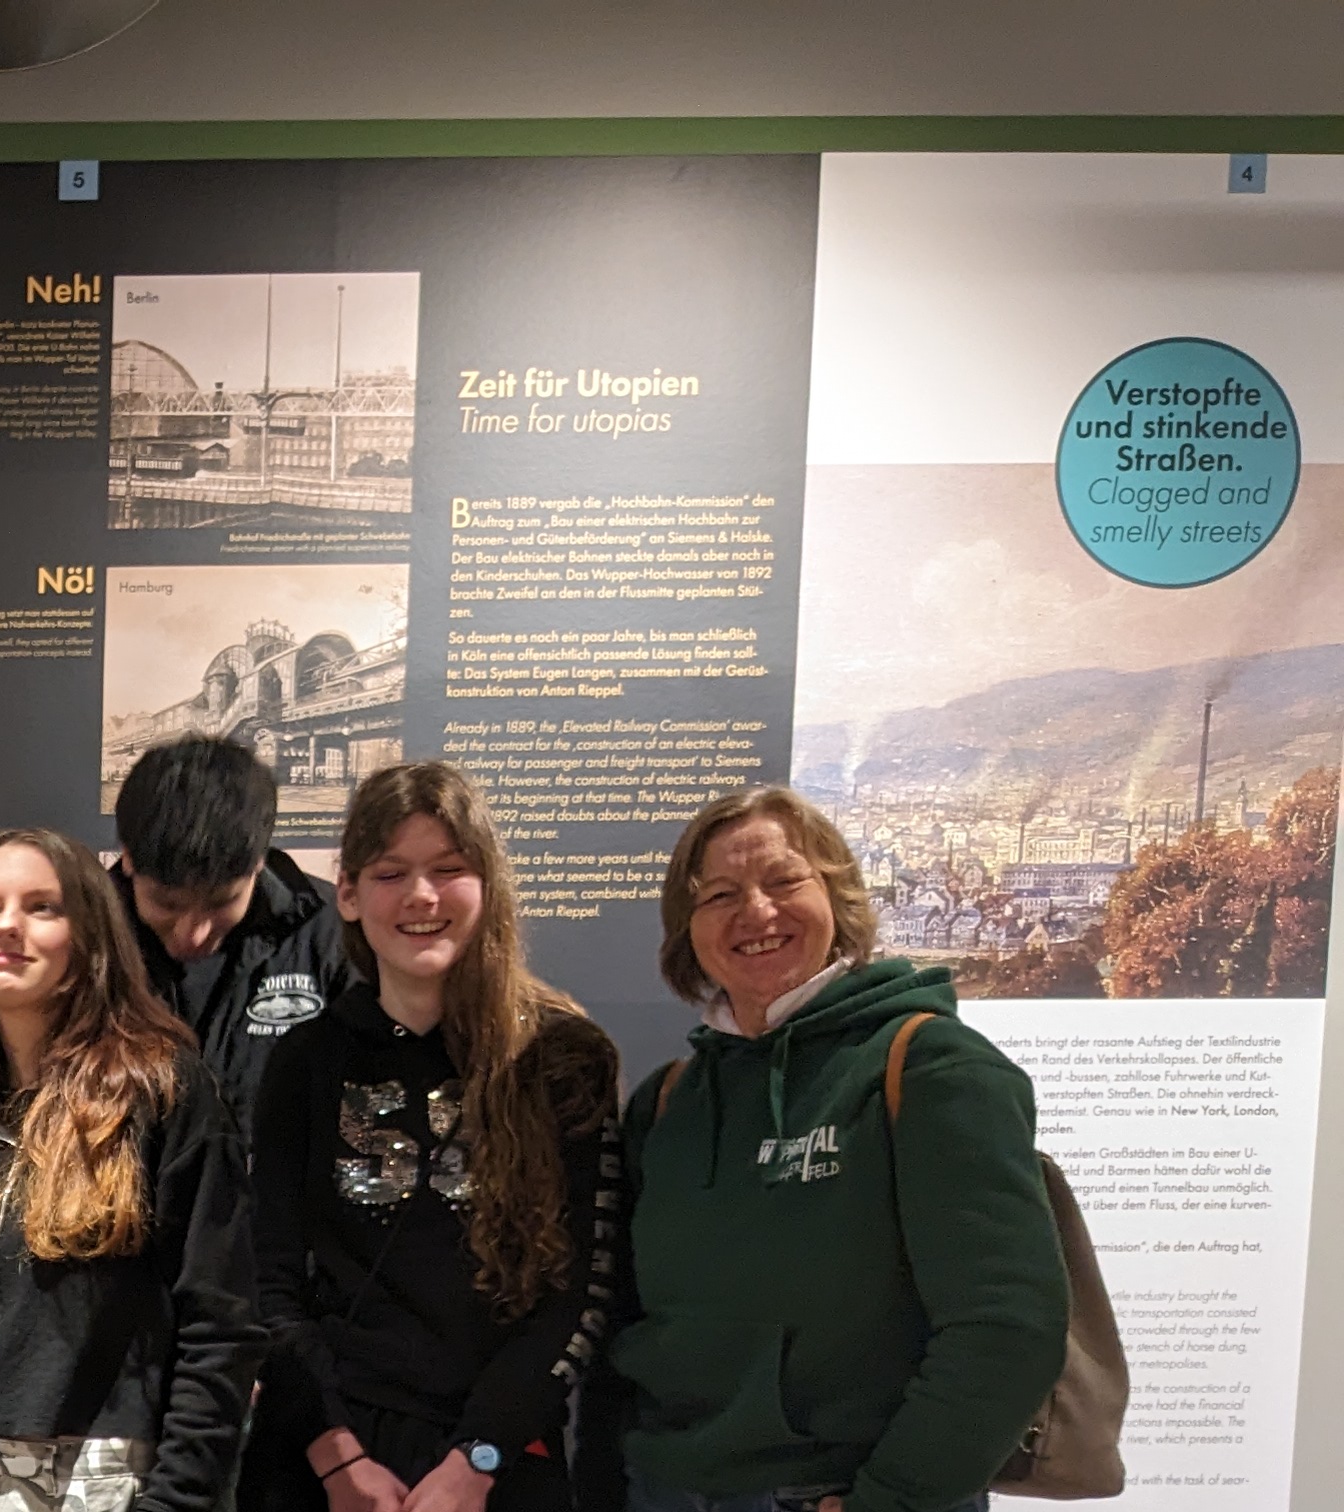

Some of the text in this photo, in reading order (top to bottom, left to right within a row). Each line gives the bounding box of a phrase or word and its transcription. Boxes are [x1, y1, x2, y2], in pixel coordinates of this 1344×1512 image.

[73, 171, 85, 188] 5
[1242, 166, 1254, 181] 4
[26, 275, 101, 304] Neh!
[126, 291, 160, 304] Berlin
[459, 368, 700, 405] Zeit für Utopien
[1106, 378, 1262, 414] Verstopfte
[460, 403, 672, 439] Time for utopias
[1076, 411, 1288, 440] und stinkende
[1116, 444, 1244, 472] Straßen.
[506, 496, 536, 509] 1889
[538, 496, 580, 512] vergab
[582, 496, 602, 509] die
[751, 494, 775, 507] den
[1088, 477, 1272, 513] Clogged and
[1089, 515, 1262, 551] smelly streets
[37, 567, 95, 595] Nö!
[119, 581, 174, 597] Hamburg
[1017, 1053, 1283, 1067] den Rand des Verkehrskollapses. Der öffentliche
[1092, 1105, 1279, 1119] Genau wie in New York, London,
